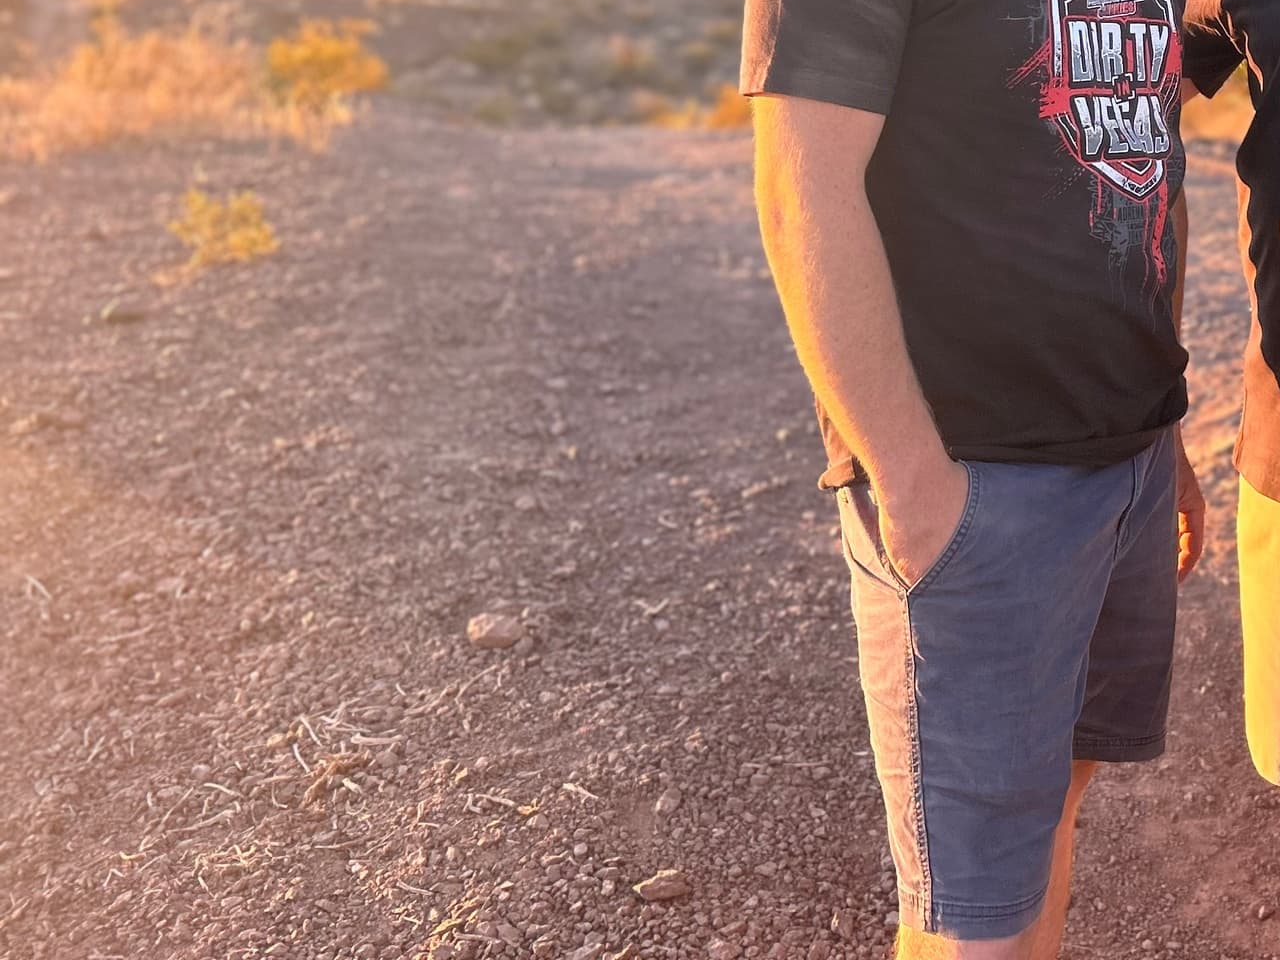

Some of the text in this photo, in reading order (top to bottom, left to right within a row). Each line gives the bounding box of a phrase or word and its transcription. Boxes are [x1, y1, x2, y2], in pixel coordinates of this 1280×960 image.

[1067, 20, 1170, 85] DIRTY
[1116, 79, 1131, 97] IN
[1073, 93, 1171, 156] VEGAS
